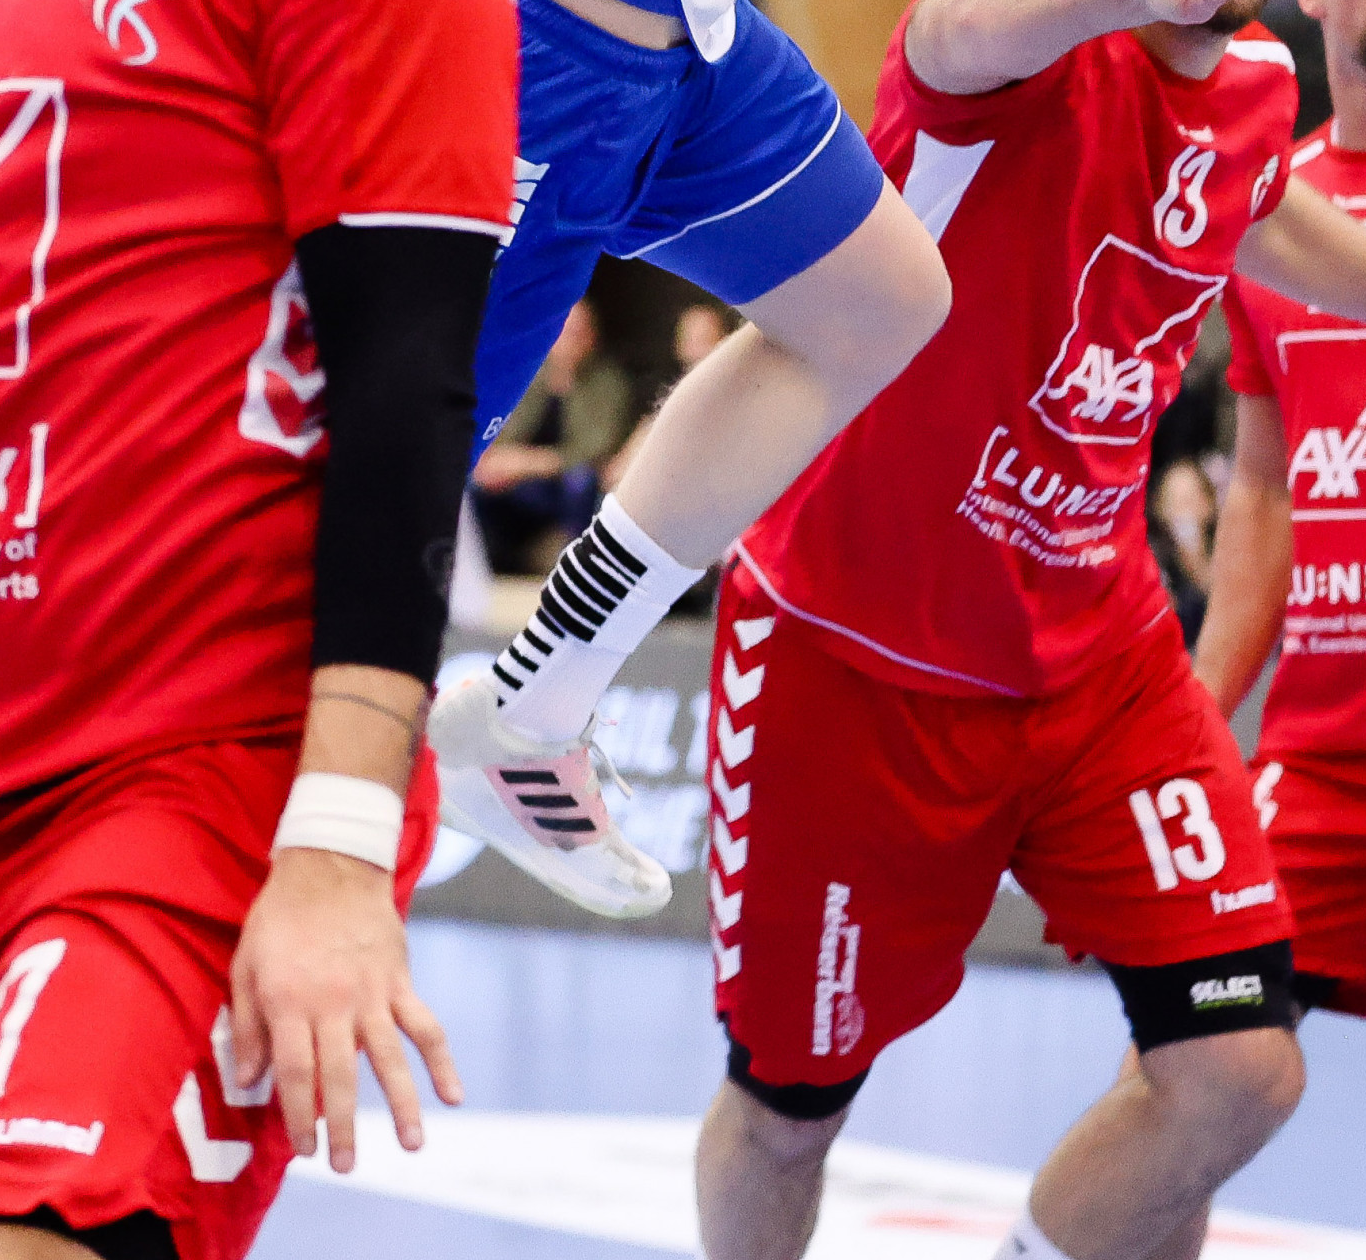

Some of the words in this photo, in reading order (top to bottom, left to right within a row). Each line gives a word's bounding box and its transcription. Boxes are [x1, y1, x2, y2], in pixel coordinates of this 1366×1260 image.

[1153, 144, 1217, 248] 13
[1046, 343, 1156, 422] AXA
[1129, 777, 1228, 893] 13
